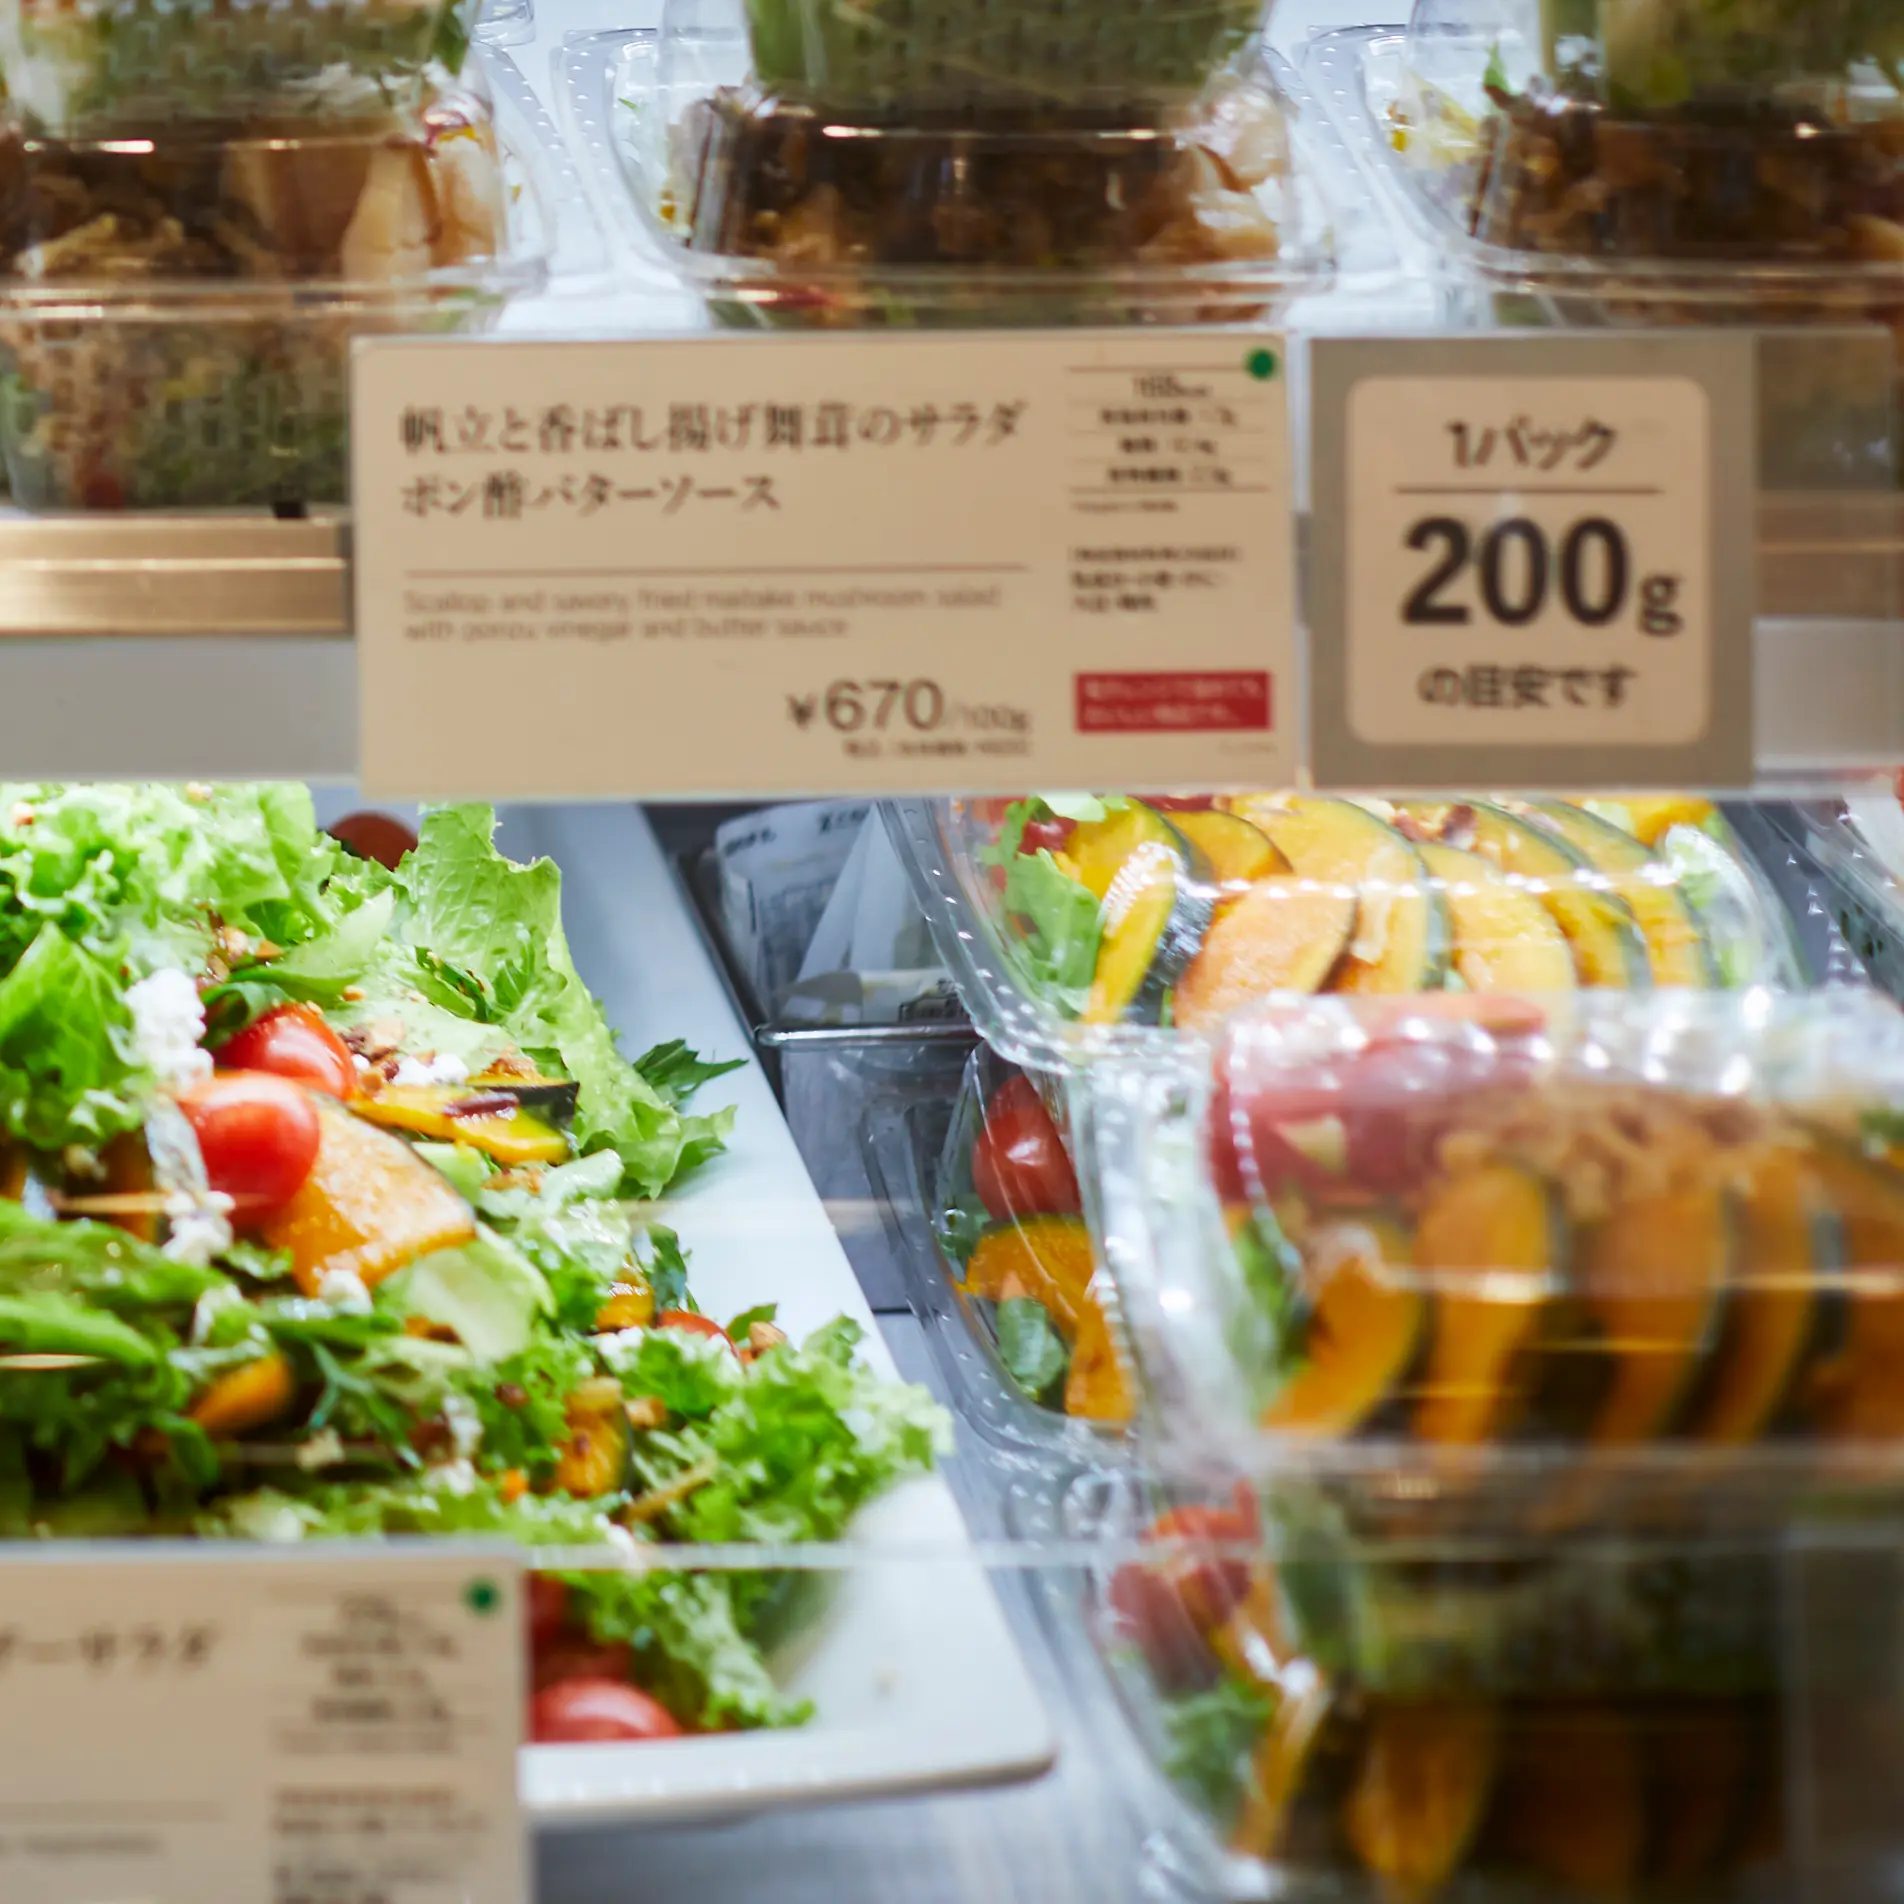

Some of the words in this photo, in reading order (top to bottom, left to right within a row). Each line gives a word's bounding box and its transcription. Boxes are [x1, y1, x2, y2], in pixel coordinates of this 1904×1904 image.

[403, 470, 781, 519] ポン酢バターソース
[1400, 515, 1683, 638] 200g
[1418, 663, 1637, 709] の目安です
